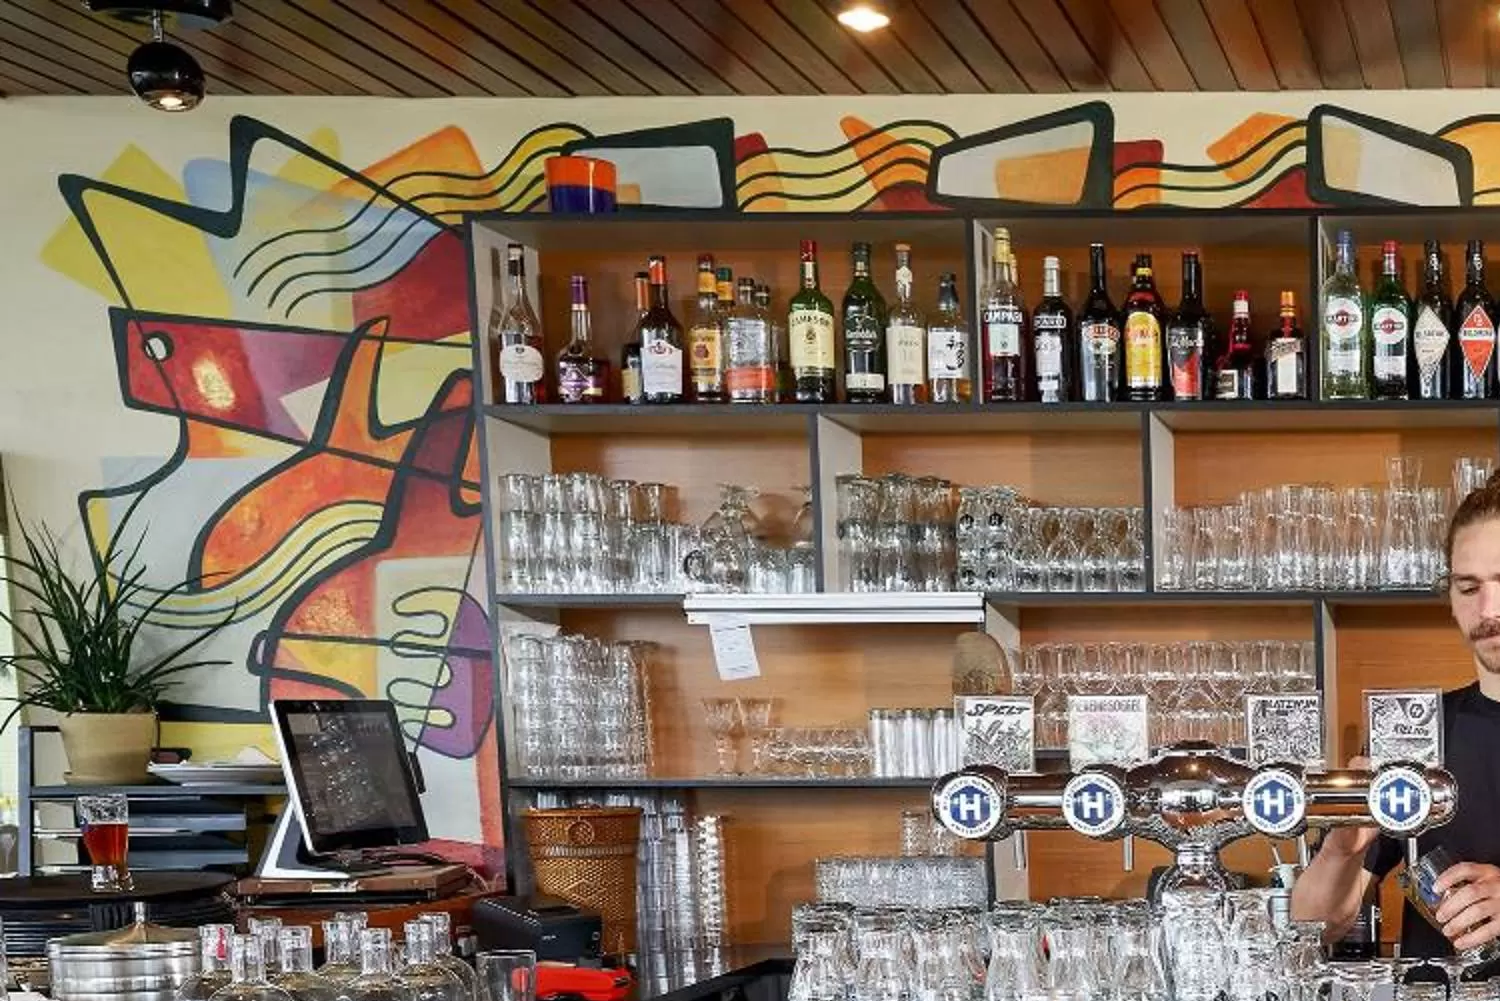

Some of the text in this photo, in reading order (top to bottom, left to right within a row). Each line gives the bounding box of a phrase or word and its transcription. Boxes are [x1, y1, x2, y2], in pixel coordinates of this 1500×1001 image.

[791, 314, 830, 327] JAMESON
[984, 312, 1023, 323] CAMPARI
[966, 703, 1030, 716] SPELT
[960, 794, 980, 820] H
[1082, 792, 1104, 818] H
[1264, 789, 1285, 815] H
[1390, 787, 1410, 813] H
